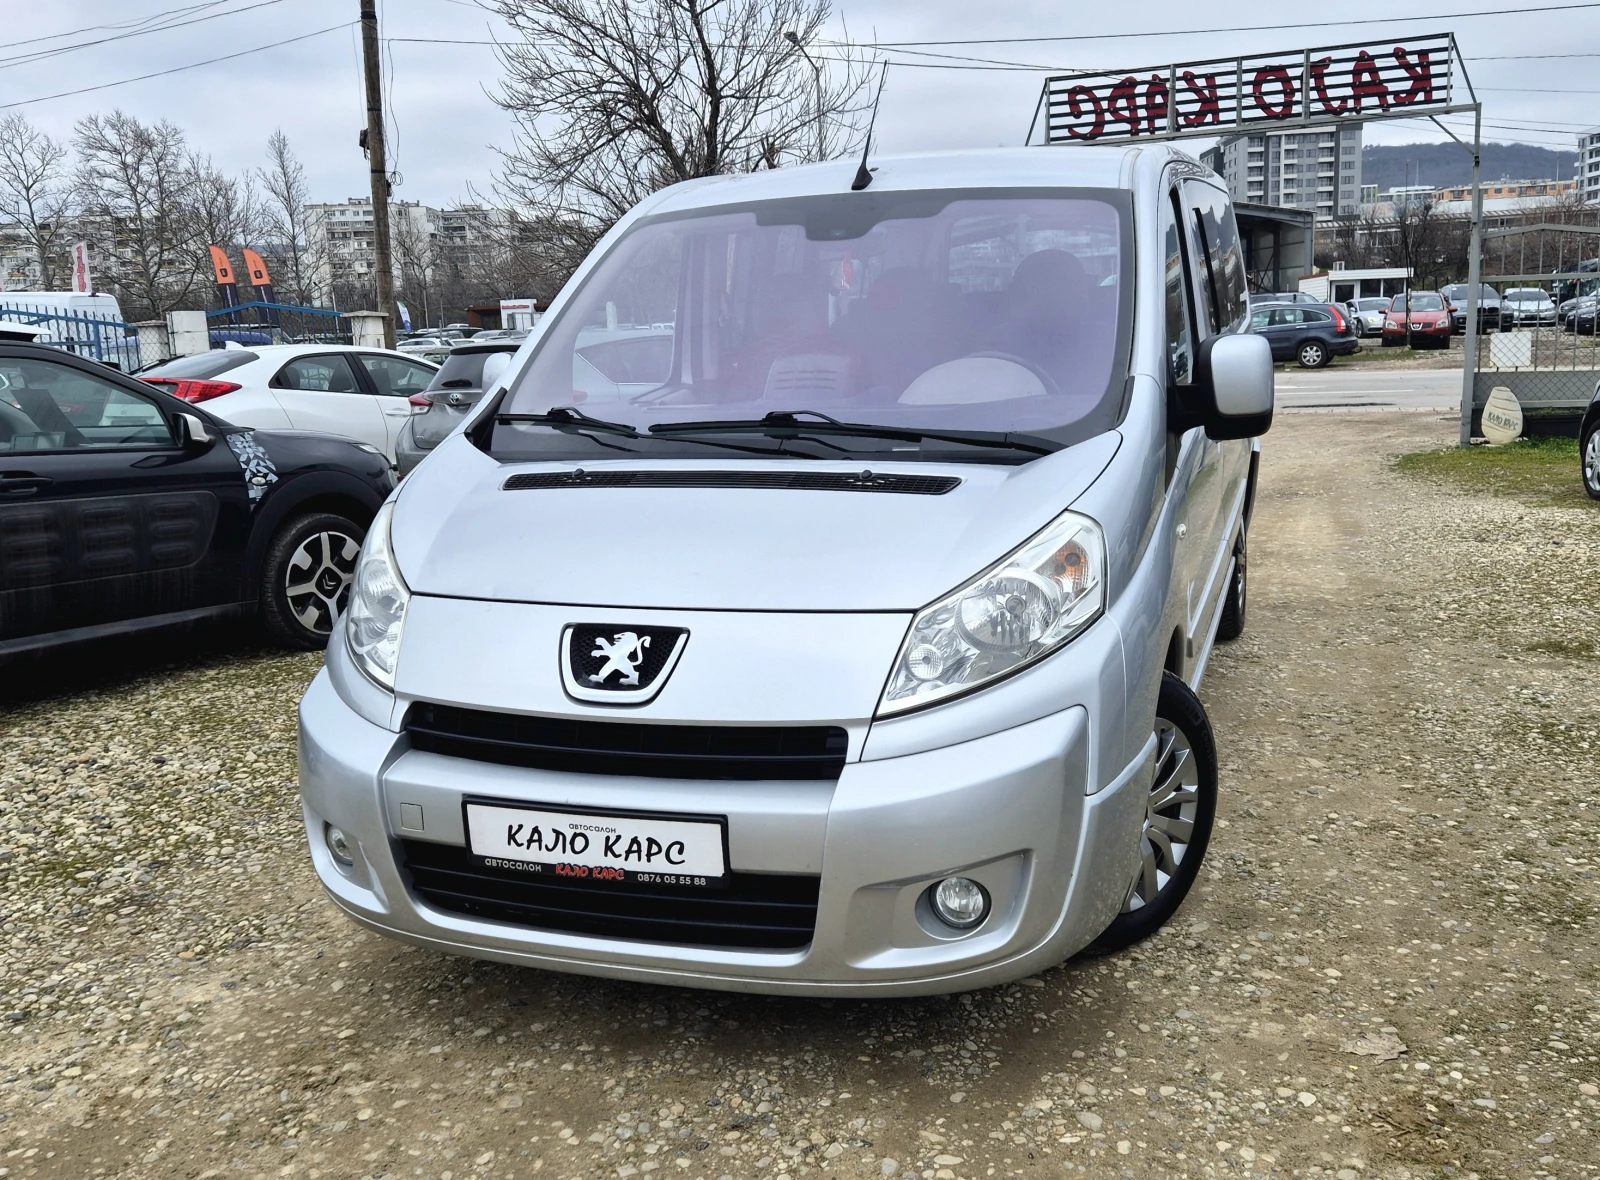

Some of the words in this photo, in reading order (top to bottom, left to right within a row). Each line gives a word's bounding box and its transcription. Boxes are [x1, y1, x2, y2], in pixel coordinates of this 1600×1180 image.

[569, 823, 616, 834] автосалон
[507, 824, 590, 855] КАЛО
[604, 834, 686, 865] КАРС
[485, 858, 542, 872] автосалон
[555, 863, 589, 878] КАЛО
[593, 866, 625, 880] КАРС
[637, 873, 662, 883] 0876
[664, 875, 676, 884] 05
[679, 876, 691, 885] 55
[693, 877, 706, 886] 88
